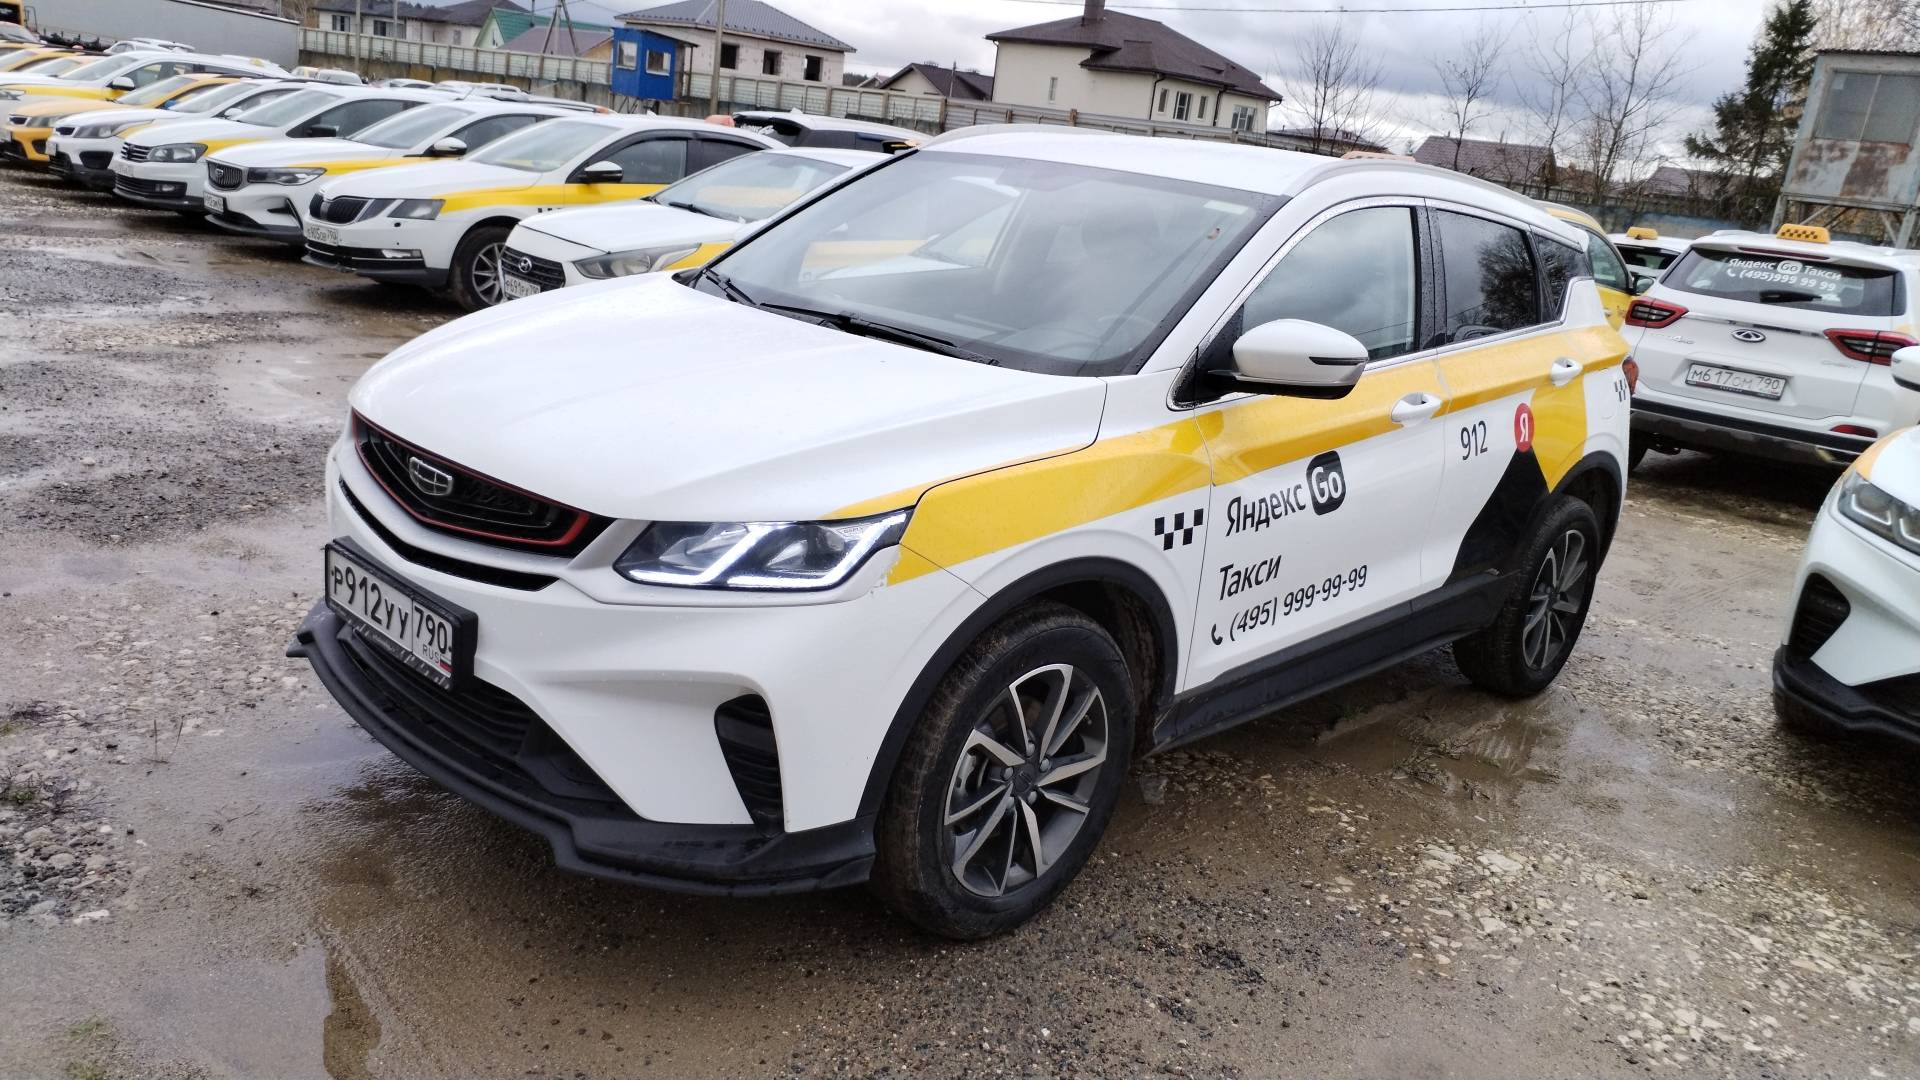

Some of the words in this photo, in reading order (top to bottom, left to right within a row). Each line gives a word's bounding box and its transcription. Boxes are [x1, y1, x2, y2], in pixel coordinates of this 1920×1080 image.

[1728, 258, 1776, 270] Яндекс
[1803, 265, 1842, 281] Такси
[1739, 269, 1797, 284] (495)999
[1800, 277, 1817, 288] 99
[1819, 281, 1837, 292] 99
[1460, 420, 1488, 460] 912
[1519, 413, 1529, 443] Я
[1225, 483, 1306, 537] Яндекс
[1311, 466, 1342, 504] Go
[1219, 554, 1282, 601] Такси
[1229, 596, 1278, 642] (495)
[1283, 564, 1368, 616] 999-99-99
[422, 644, 440, 664] RUS
